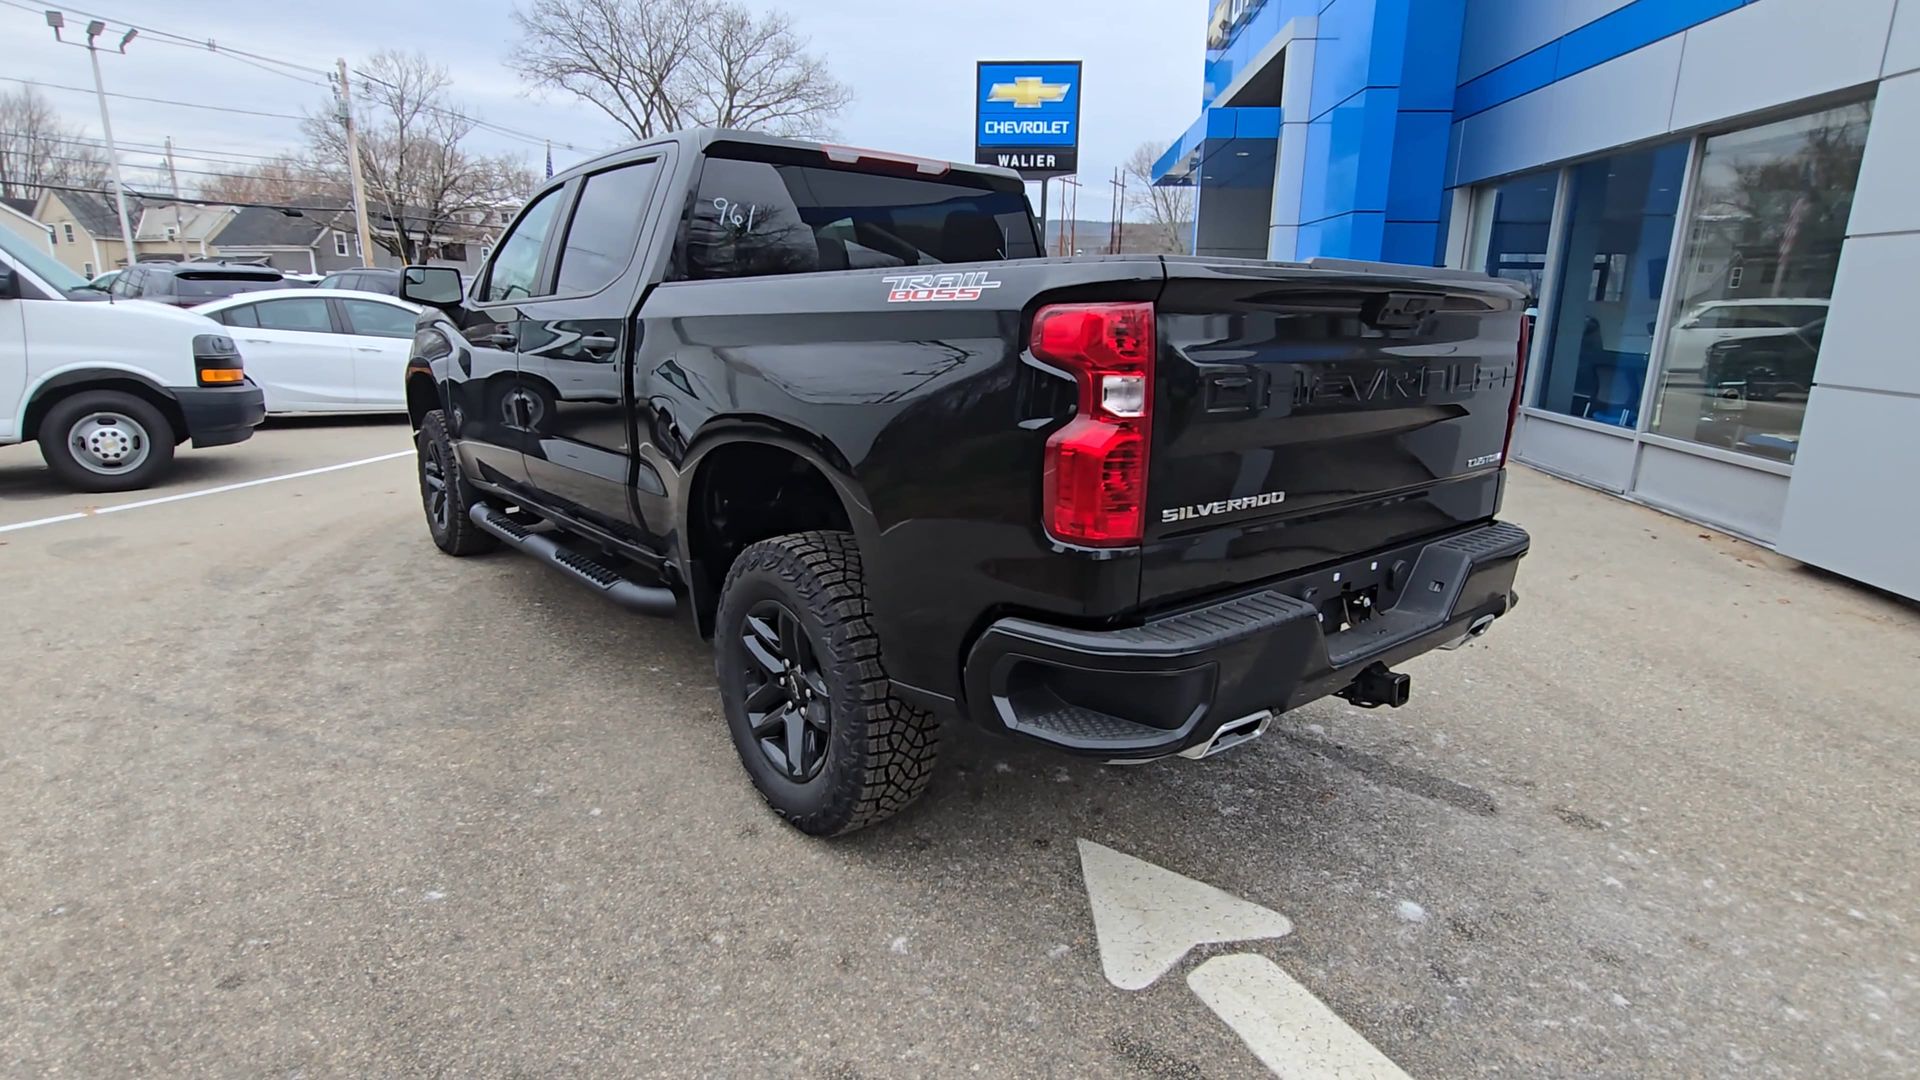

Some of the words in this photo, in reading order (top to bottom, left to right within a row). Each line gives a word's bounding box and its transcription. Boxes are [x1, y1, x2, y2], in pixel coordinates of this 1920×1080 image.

[984, 121, 1070, 134] CHEVROLET
[998, 154, 1056, 167] WALIER
[713, 197, 756, 232] 961
[882, 271, 1001, 289] TRAIL
[887, 288, 982, 303] BOSS
[1161, 491, 1286, 523] SILVERADO
